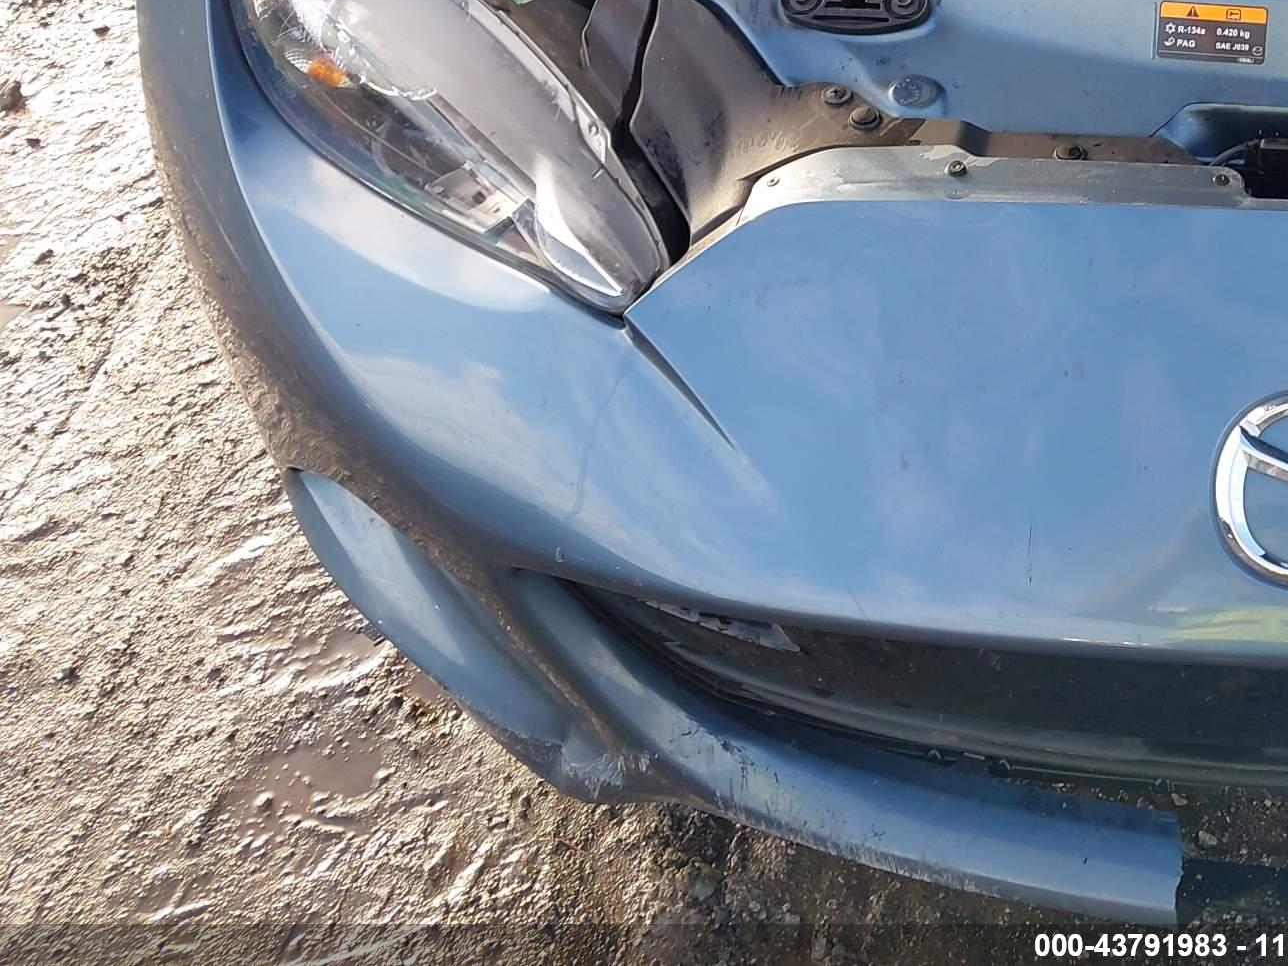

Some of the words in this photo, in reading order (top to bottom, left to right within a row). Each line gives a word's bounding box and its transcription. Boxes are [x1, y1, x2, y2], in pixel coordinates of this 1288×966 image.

[1177, 25, 1206, 35] R-134a
[1216, 27, 1238, 37] 0.420
[1239, 29, 1250, 40] kg
[1176, 39, 1196, 48] PAG
[1215, 42, 1231, 50] SAE
